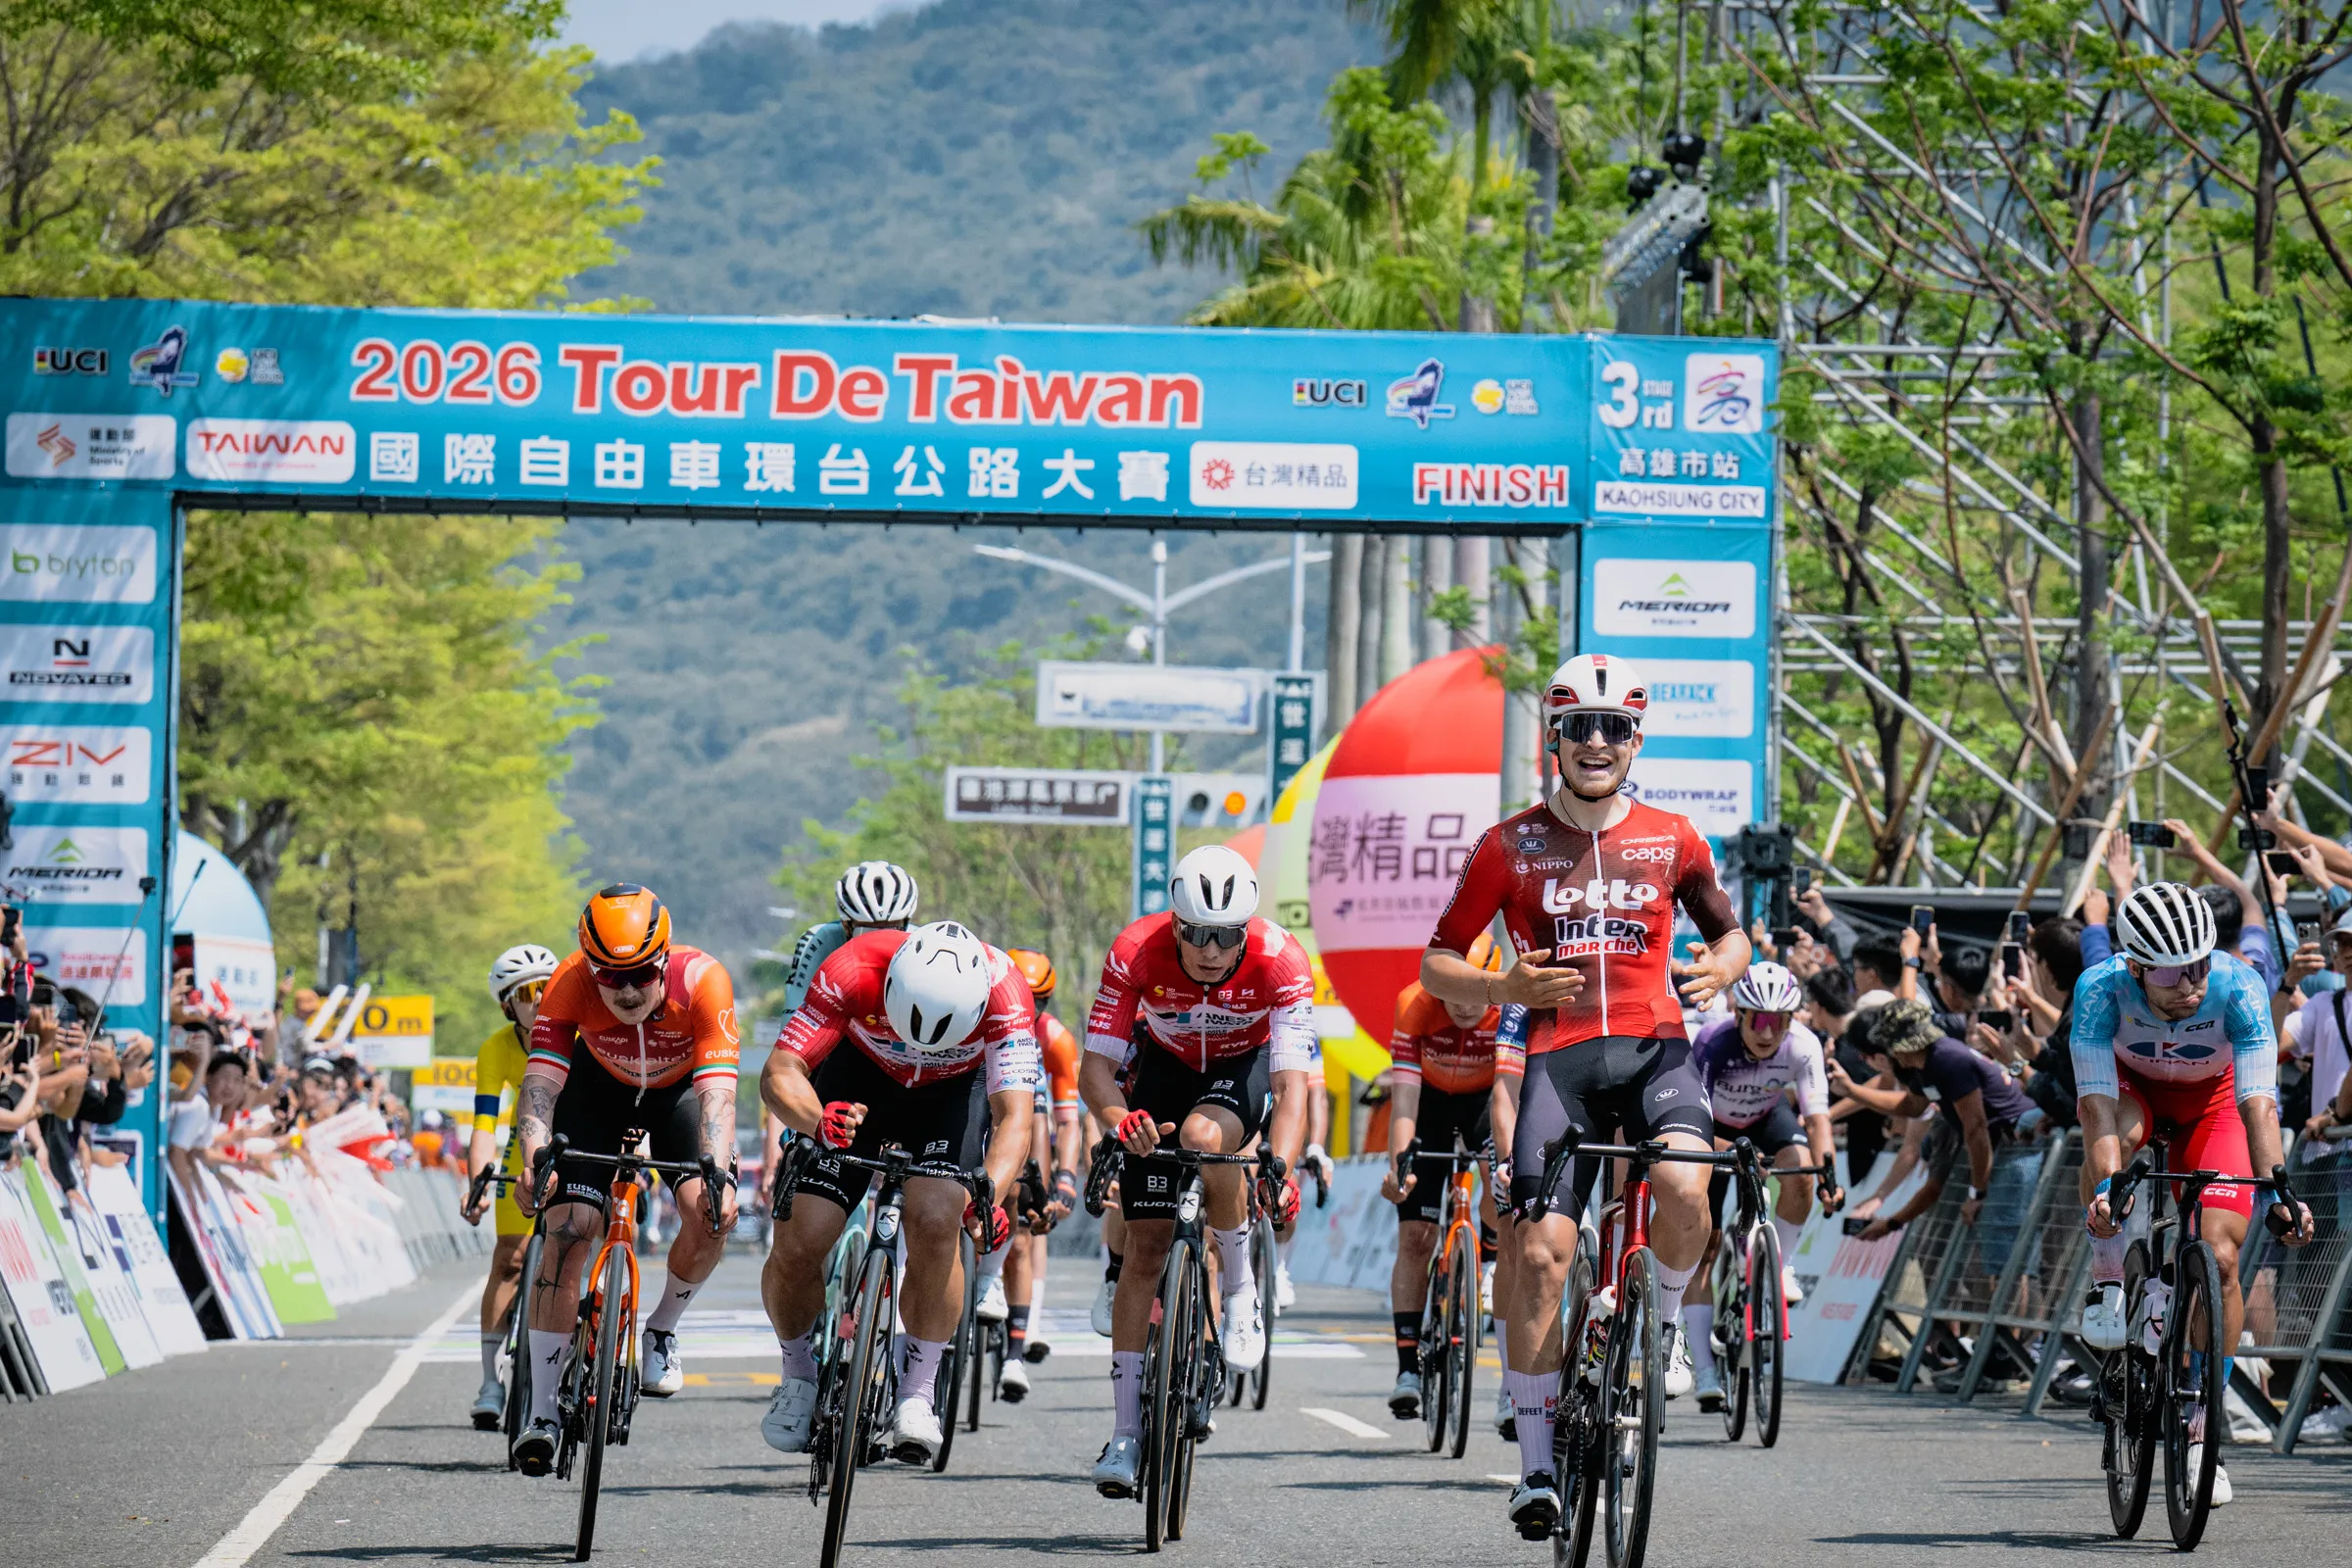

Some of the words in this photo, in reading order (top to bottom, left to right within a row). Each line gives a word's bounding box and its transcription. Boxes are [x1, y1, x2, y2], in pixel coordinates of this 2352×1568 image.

[51, 350, 107, 371] UCI
[353, 340, 540, 402] 2026
[560, 345, 758, 417] Tour
[773, 349, 886, 422] De
[896, 354, 1202, 428] Taiwan
[1309, 381, 1364, 404] UCI
[1598, 361, 1640, 428] 3
[1642, 401, 1674, 428] rd
[198, 432, 345, 456] TAIWAN
[369, 431, 1169, 502] 國際自由車環台公路大賽
[1619, 448, 1740, 479] 高雄市站
[1244, 460, 1348, 488] 台灣精品
[1415, 464, 1568, 506] FINISH
[1602, 488, 1713, 509] KAOHSIUNG
[1719, 492, 1760, 511] CITY
[48, 552, 135, 579] bryton
[1619, 600, 1732, 614] MERIDA
[14, 671, 128, 685] NOVATEC
[12, 741, 126, 766] ZIV
[1643, 788, 1739, 802] BODYWRAP
[1309, 811, 1472, 884] 灣精品
[1620, 835, 1677, 845] ORBEA
[1621, 846, 1676, 864] caps
[9, 866, 123, 879] MERIDA
[1532, 859, 1574, 871] NIPPO
[2134, 935, 2147, 950] uvex
[785, 930, 815, 985] KERN
[796, 938, 824, 989] PHARMA
[1089, 1019, 1112, 1030] MJS
[599, 1035, 629, 1045] EUSKADI
[1219, 1040, 1250, 1050] KYB
[2132, 1054, 2211, 1066] KINAN
[925, 1140, 950, 1152] B3
[1147, 1175, 1168, 1189] B3
[1660, 1282, 1686, 1293] DEFEET
[1517, 1406, 1544, 1416] DEFEET
